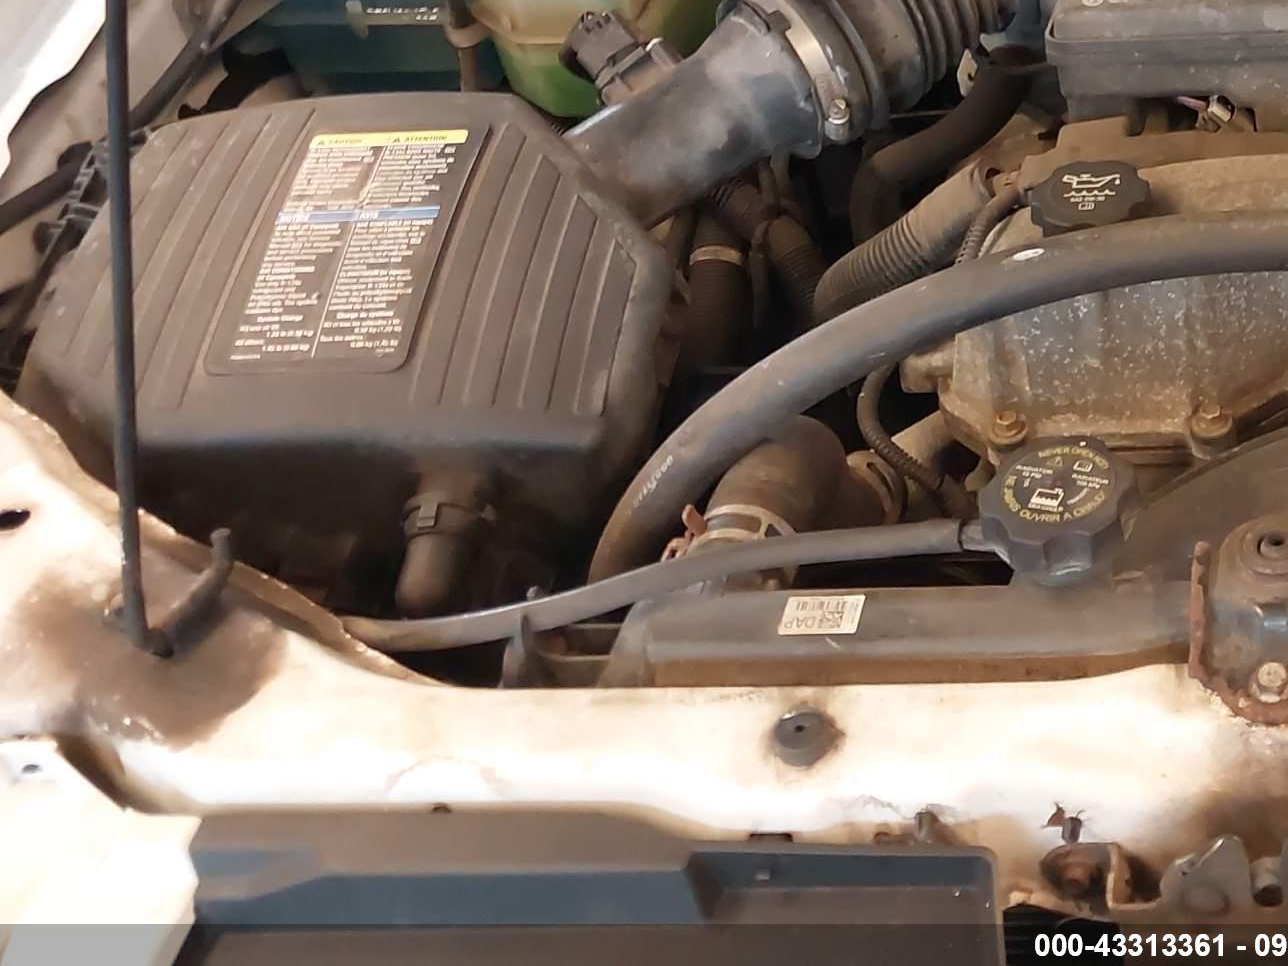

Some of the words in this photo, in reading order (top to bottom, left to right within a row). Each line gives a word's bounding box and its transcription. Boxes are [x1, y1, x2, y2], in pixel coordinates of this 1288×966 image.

[1038, 447, 1070, 459] NEVER
[1071, 446, 1094, 458] OPEN
[1019, 508, 1061, 523] OUVRIR
[784, 616, 816, 629] DAP
